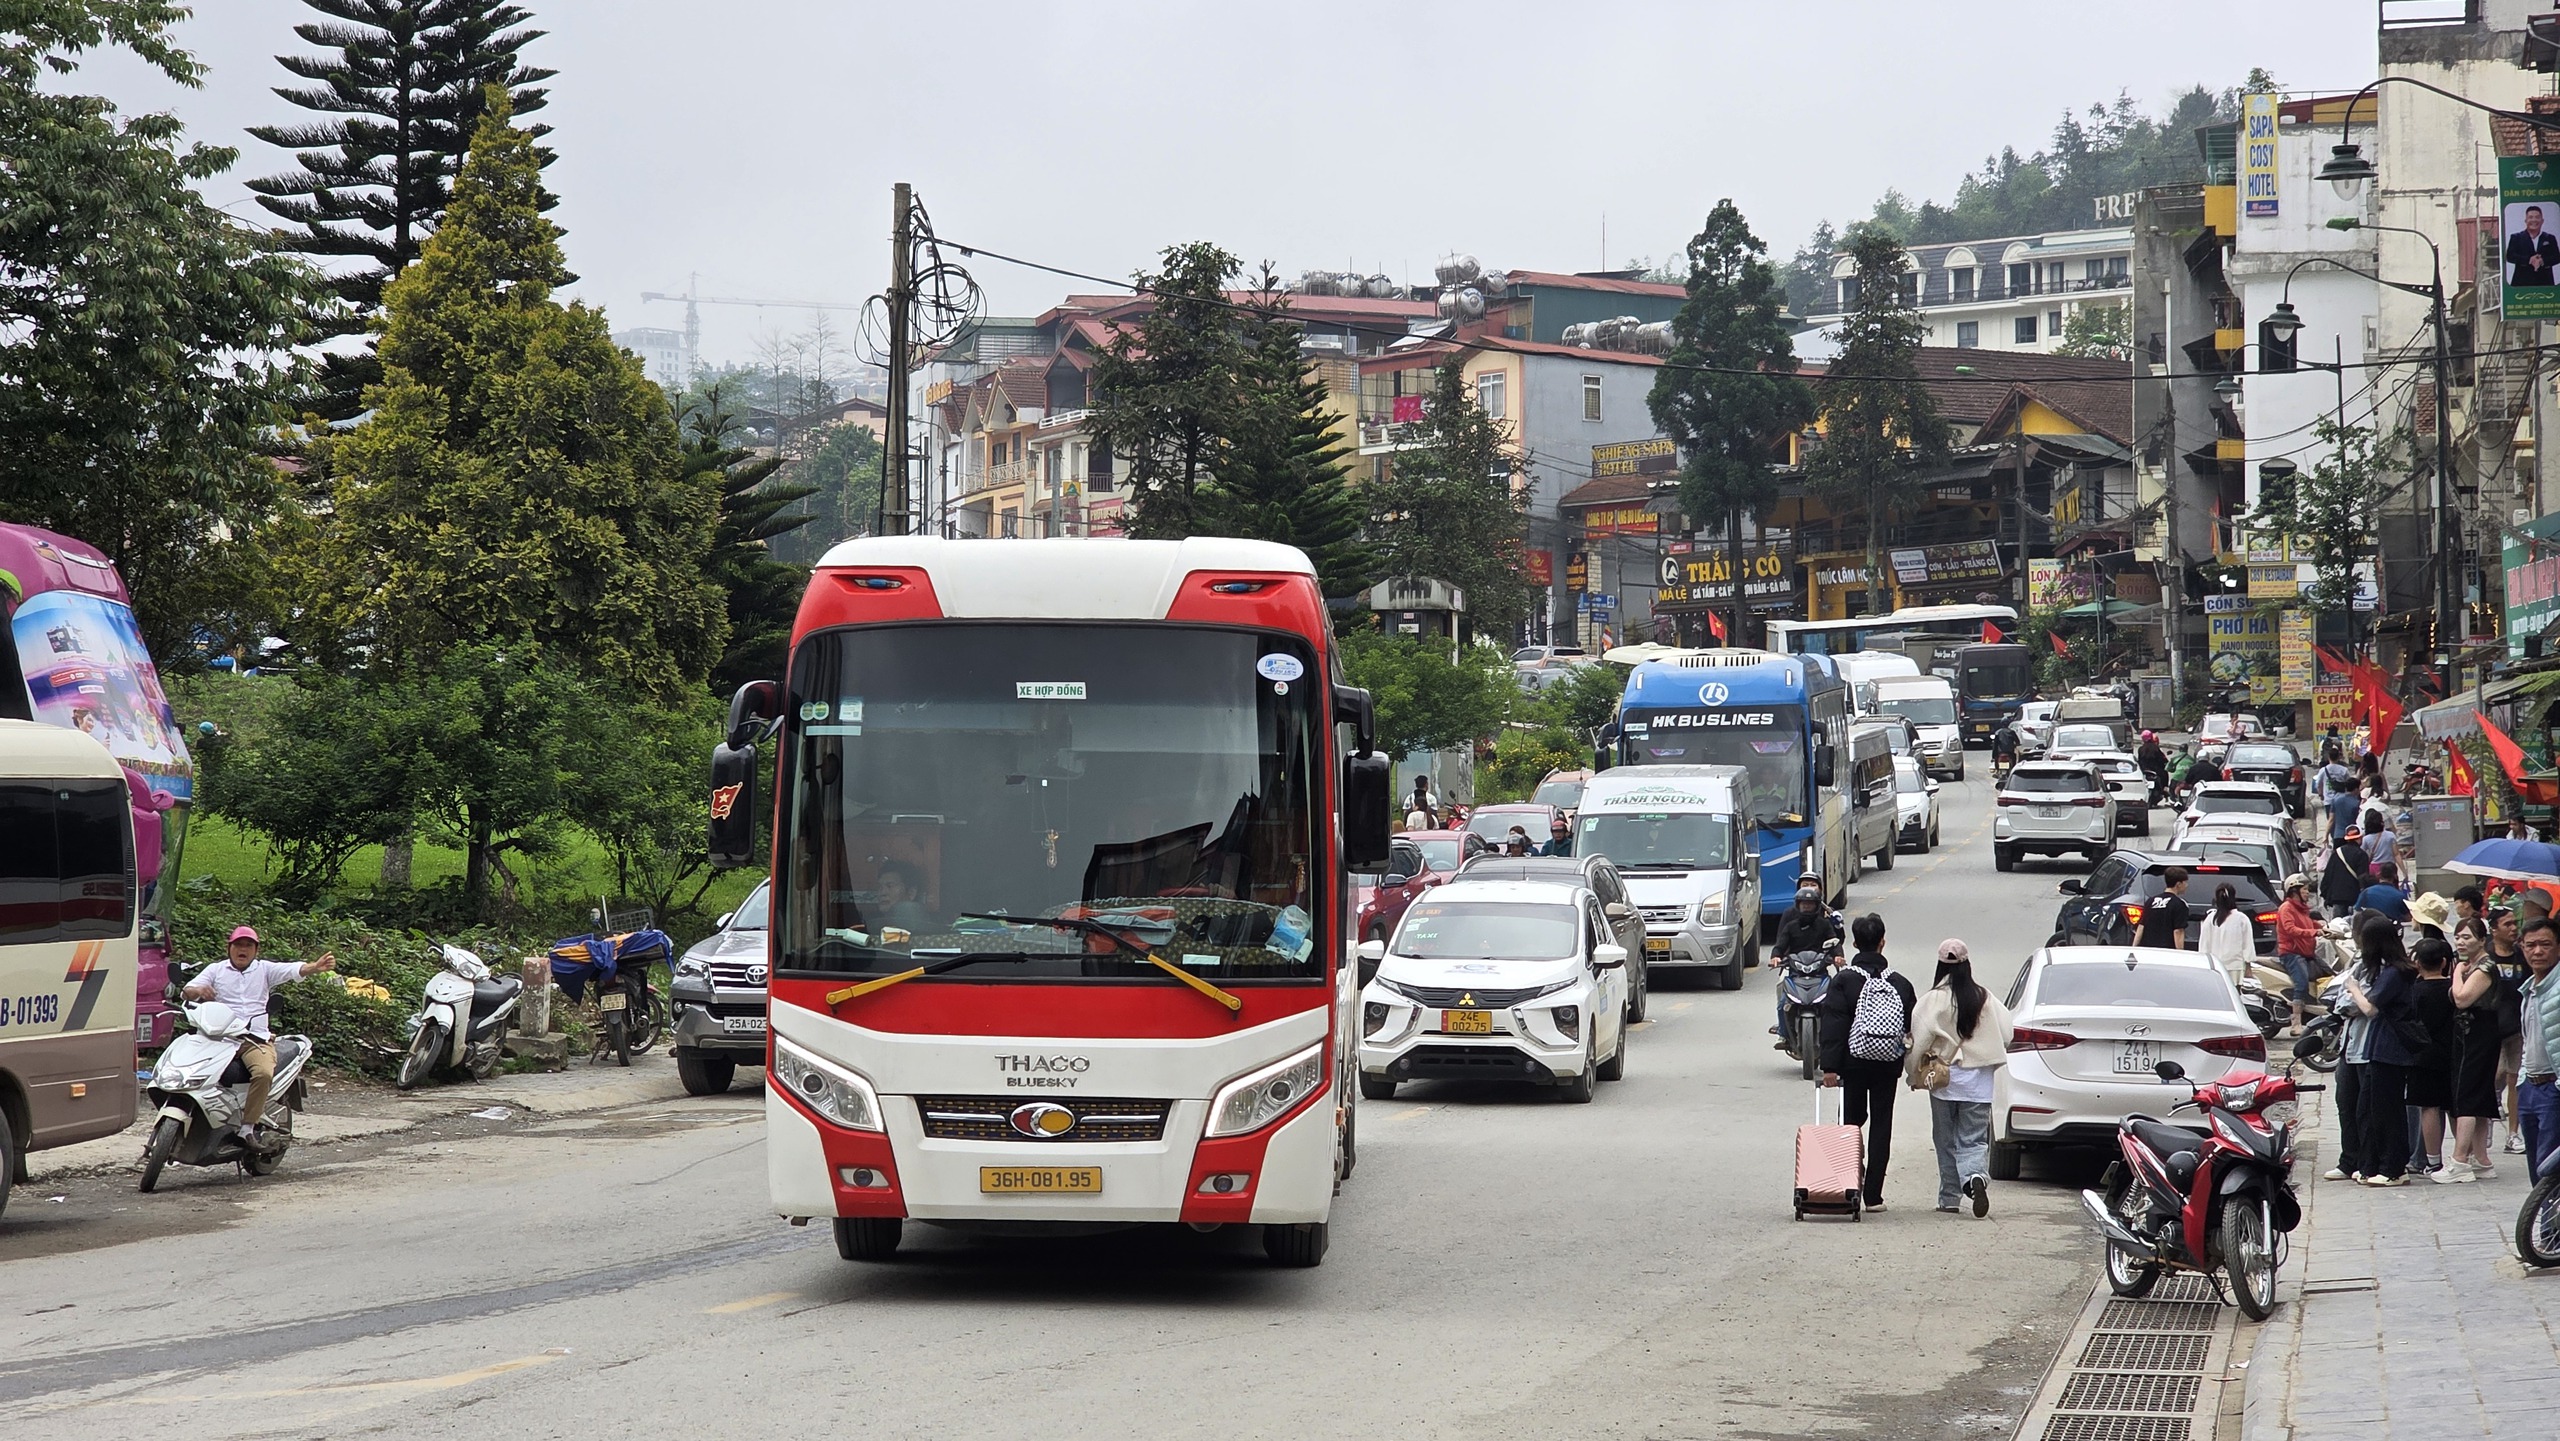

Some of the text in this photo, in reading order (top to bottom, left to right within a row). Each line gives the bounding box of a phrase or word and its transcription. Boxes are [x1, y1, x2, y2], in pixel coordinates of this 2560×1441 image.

[2250, 115, 2274, 138] SAPA
[2250, 144, 2275, 168] COSY
[2515, 170, 2542, 178] SAPA
[2248, 173, 2276, 197] HOTEL
[1643, 440, 1676, 456] SAPA
[1600, 460, 1637, 476] HOTEL
[1755, 541, 1781, 577] CỐ
[1837, 566, 1857, 584] LÂM
[2220, 641, 2243, 651] HANOI
[1019, 683, 1083, 698] XE HỢP ĐỒNG
[2316, 693, 2353, 705] CƠM
[1652, 713, 1774, 728] HK BUSLINES
[1651, 795, 1708, 805] NGUYÊN
[1460, 1011, 1479, 1021] 24E
[1452, 1021, 1487, 1032] 002.75
[2124, 1040, 2149, 1056] 24A
[994, 1054, 1091, 1072] THACO
[1006, 1077, 1078, 1088] BLUESKY
[991, 1171, 1091, 1188] 36H-081.95
